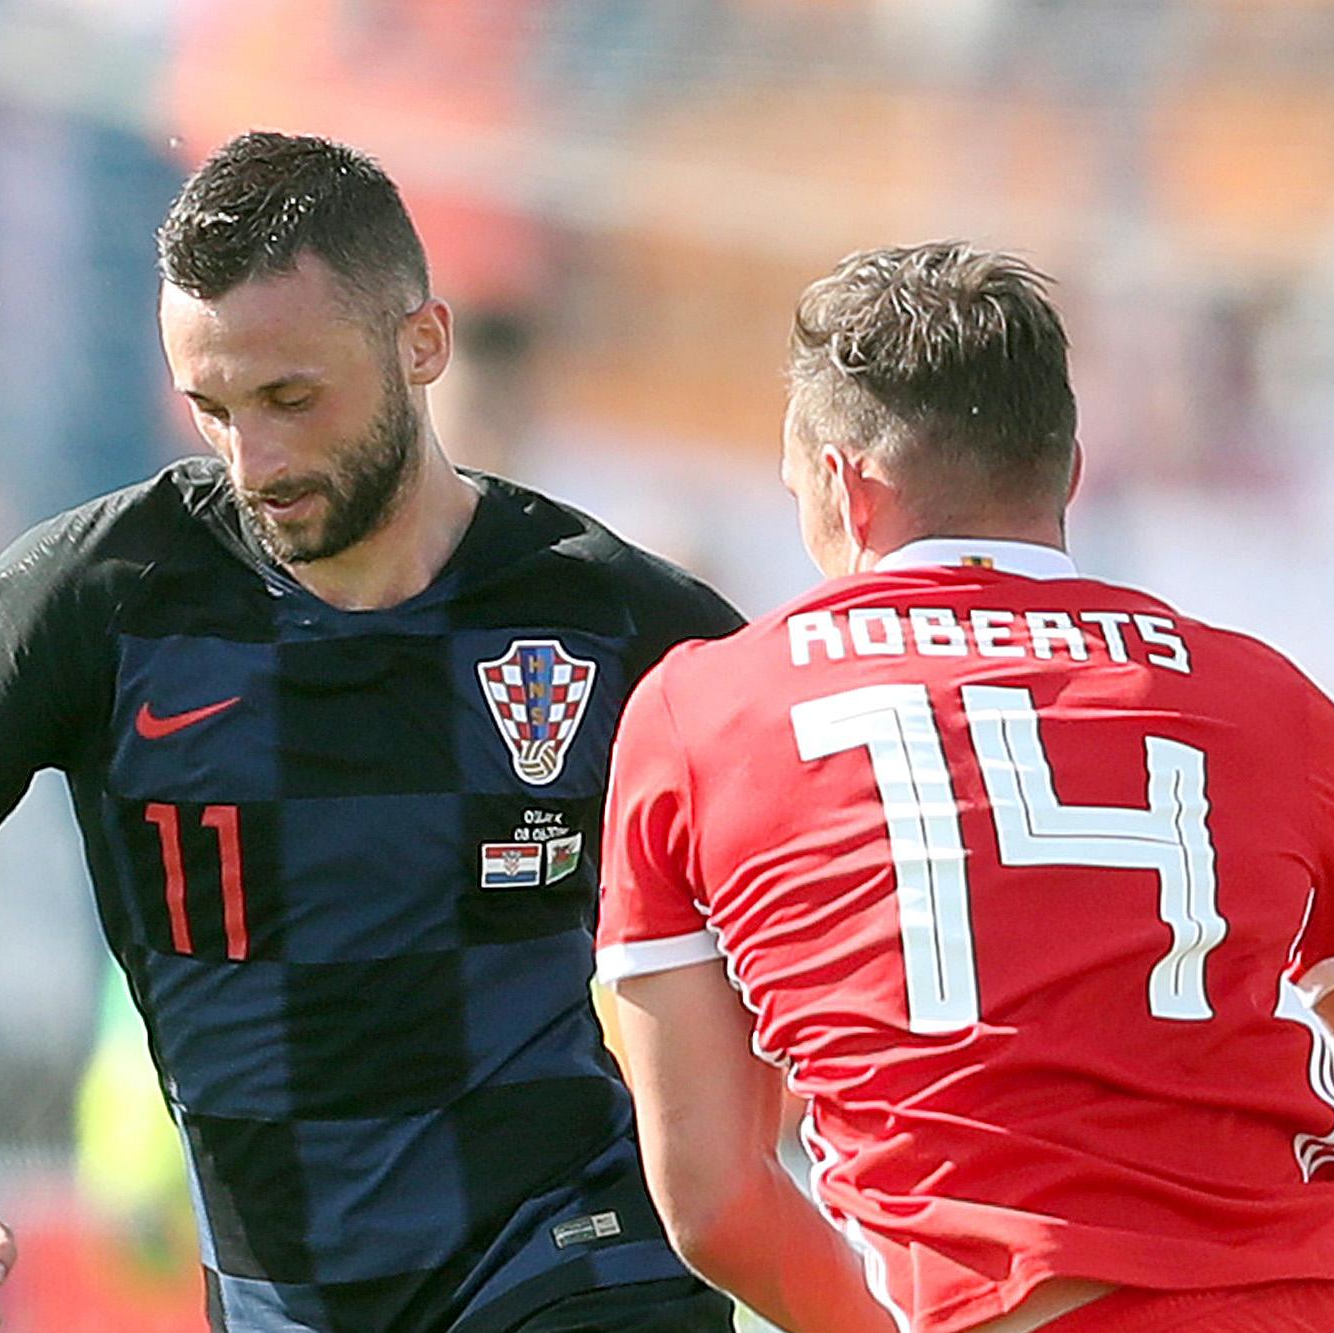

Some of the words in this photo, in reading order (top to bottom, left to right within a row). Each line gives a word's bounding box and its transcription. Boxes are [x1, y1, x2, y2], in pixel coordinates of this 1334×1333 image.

[787, 606, 1192, 674] ROBERTS
[144, 803, 249, 961] 11
[790, 683, 1228, 1034] 14
